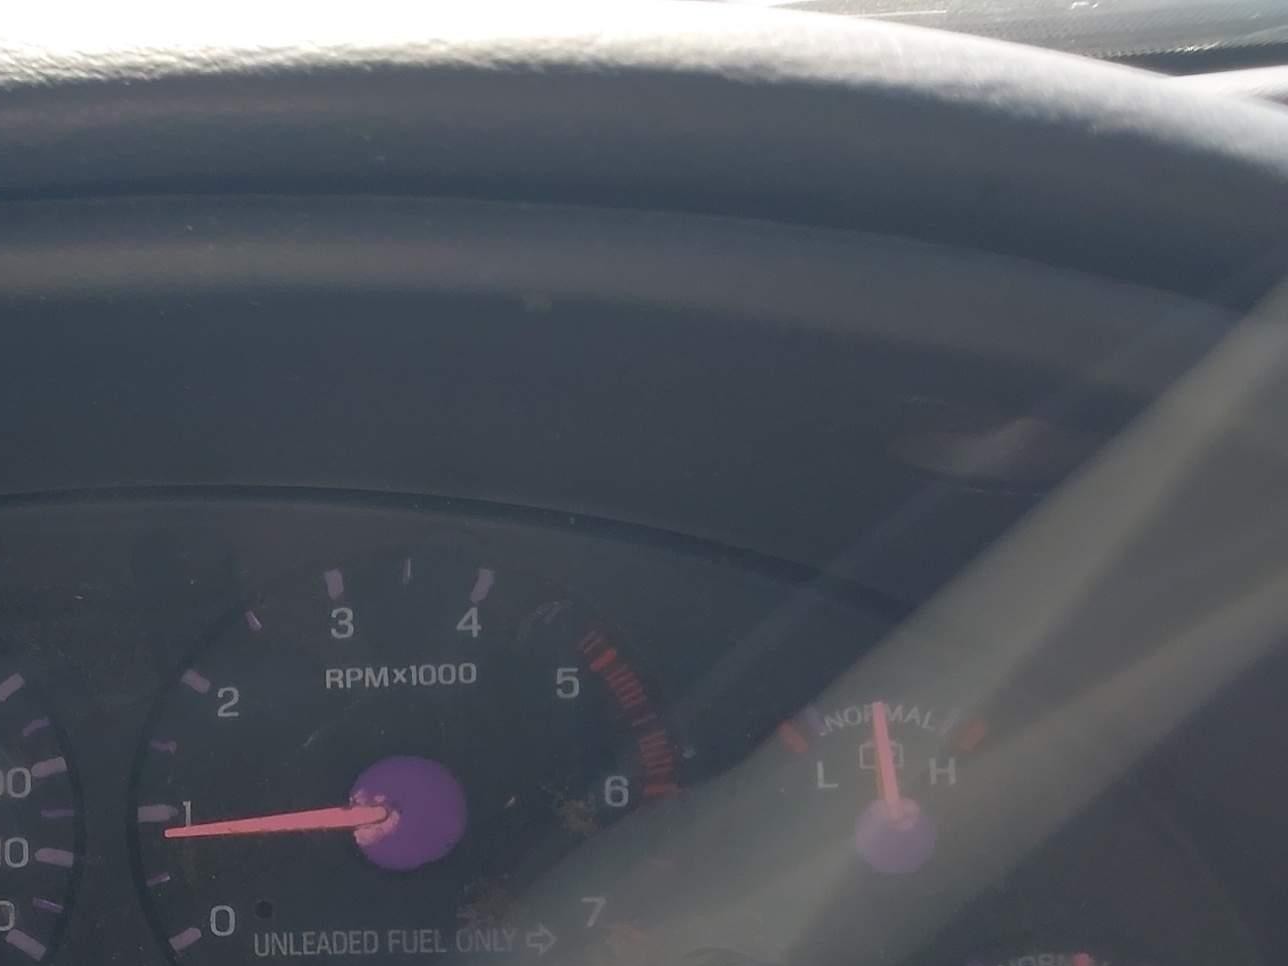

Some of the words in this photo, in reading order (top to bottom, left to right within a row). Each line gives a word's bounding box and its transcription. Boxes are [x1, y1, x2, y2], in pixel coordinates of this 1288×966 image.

[329, 607, 356, 639] 3
[455, 607, 483, 639] 4
[555, 666, 580, 700] 5
[216, 686, 241, 719] 2
[816, 760, 840, 789] L
[929, 756, 956, 785] H
[603, 774, 630, 807] 6
[183, 800, 192, 827] 1
[209, 904, 238, 937] 0
[580, 896, 607, 928] 7
[254, 930, 379, 957] UNLEADED
[387, 929, 447, 953] FUEL
[455, 927, 517, 953] ONLY
